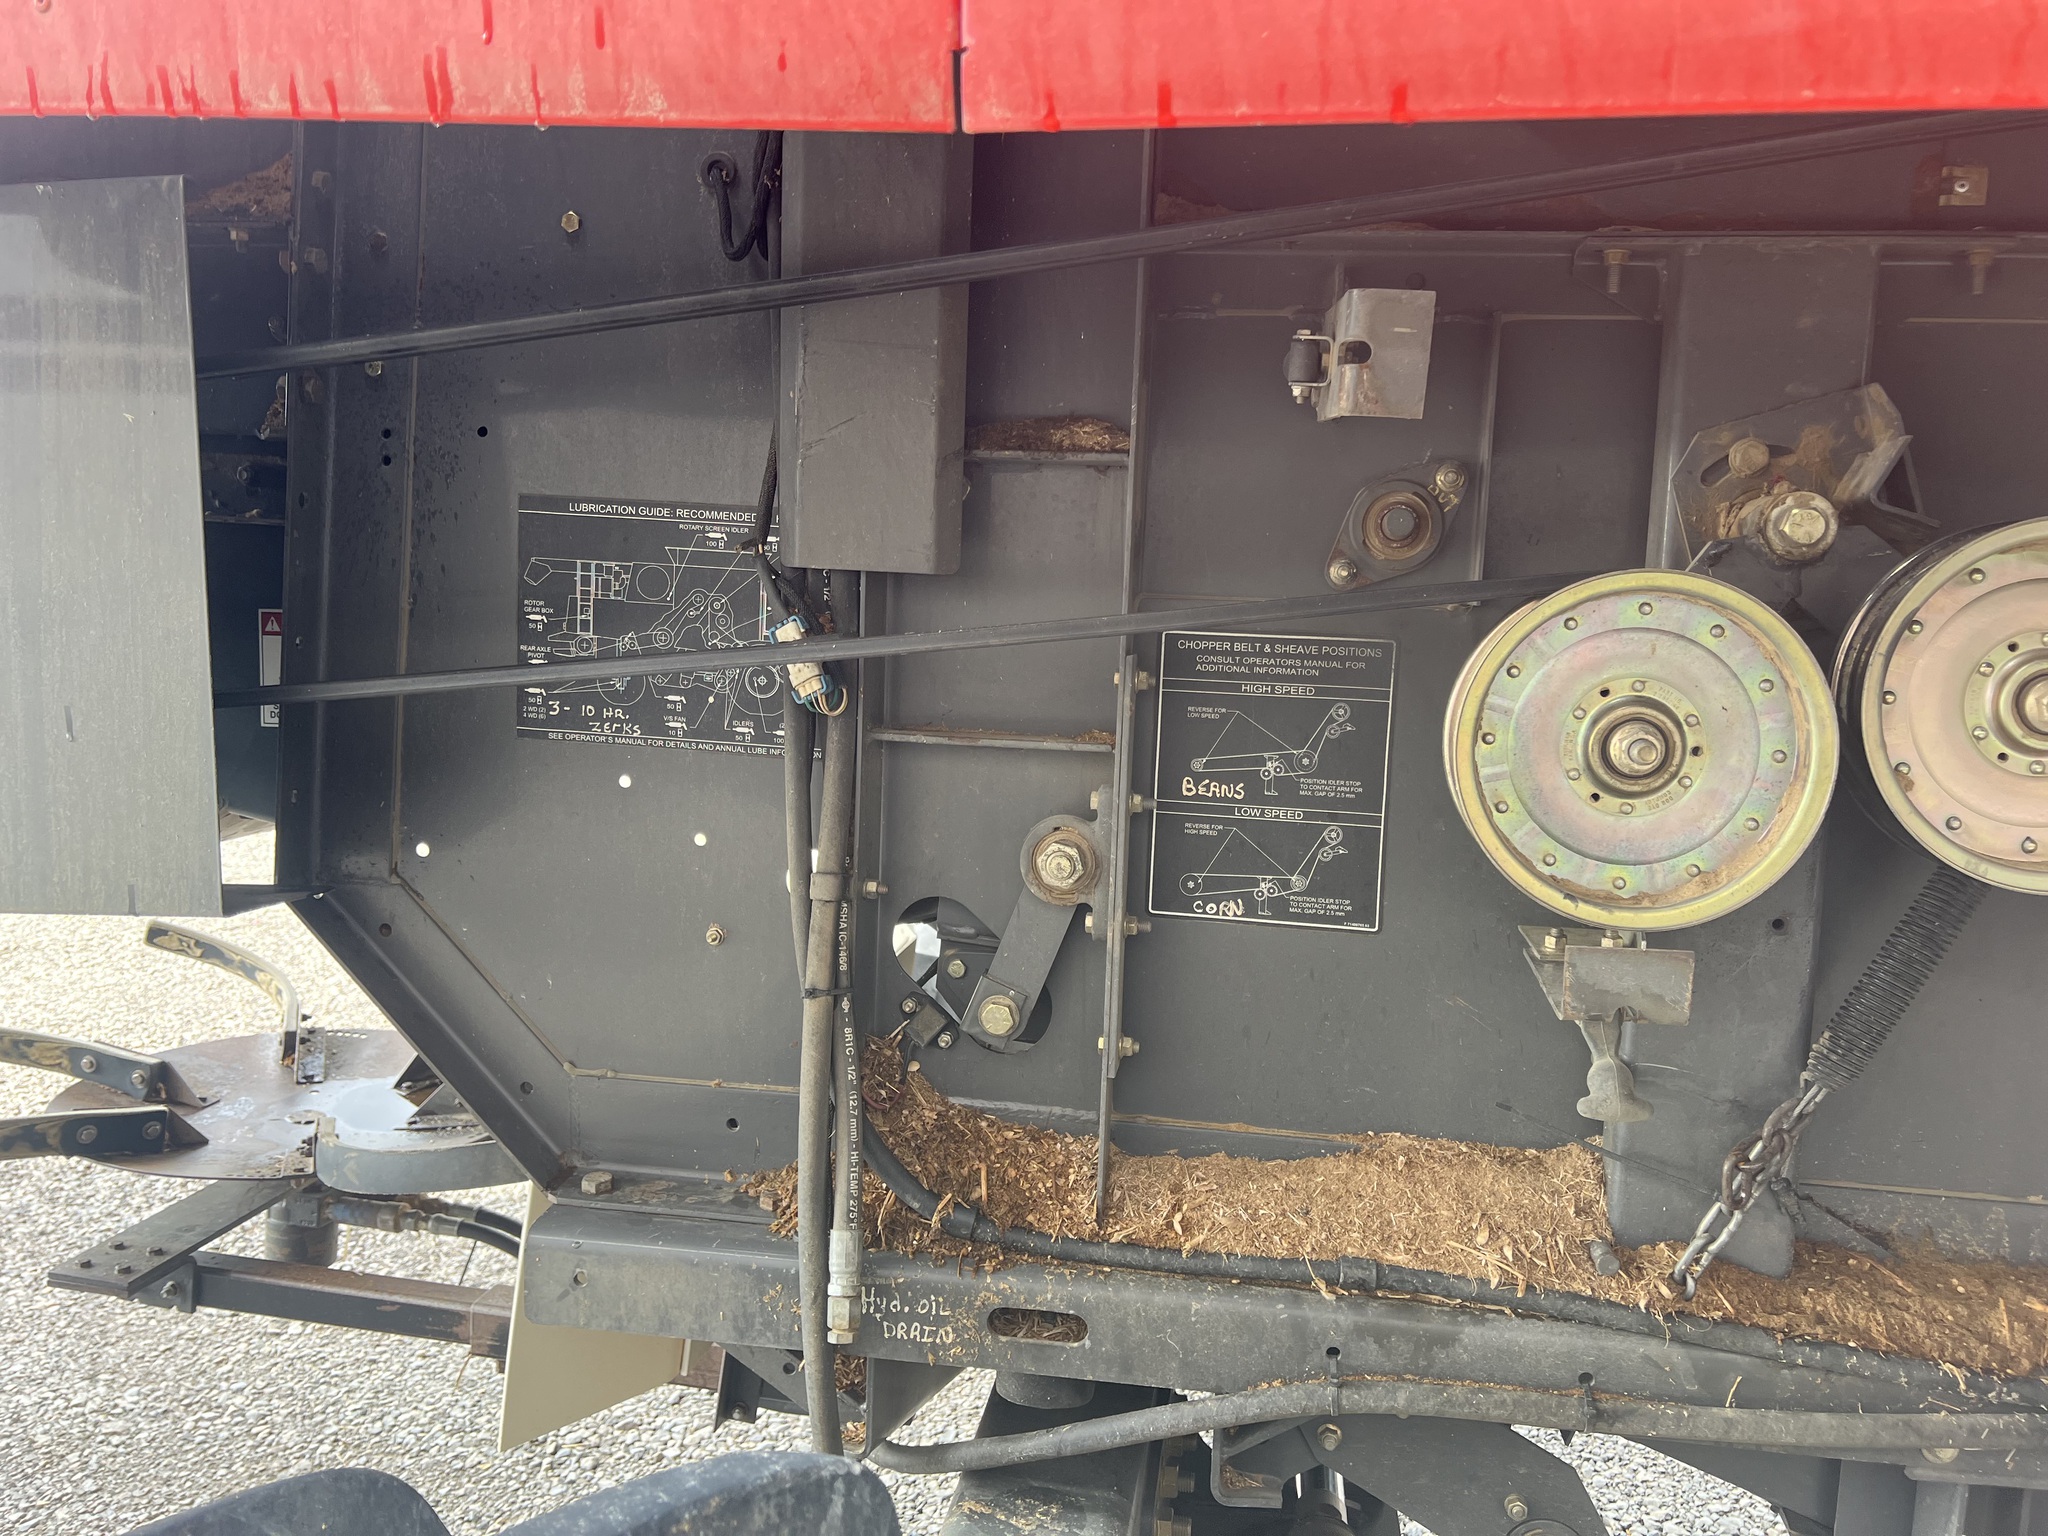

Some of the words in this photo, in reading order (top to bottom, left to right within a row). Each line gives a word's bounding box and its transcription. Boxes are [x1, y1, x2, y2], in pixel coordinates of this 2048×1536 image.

[569, 502, 636, 515] LUBRICATION
[638, 506, 674, 518] GUIDE:
[1178, 640, 1231, 651] CHOPPER
[1234, 643, 1261, 652] BELT
[1264, 644, 1271, 653] &
[1274, 644, 1319, 655] SHEAVE
[1322, 646, 1383, 658] POSITIONS
[1195, 664, 1251, 674] ADDITIONAL
[1254, 667, 1319, 676] INFORMATION
[1196, 655, 1241, 664] CONSULT
[1242, 657, 1301, 666] OPERATORS
[1304, 660, 1343, 668] MANUAL
[1241, 684, 1271, 694] HIGH
[1274, 686, 1315, 696] SPEED
[548, 700, 560, 715] 3
[582, 705, 595, 717] 10
[603, 707, 629, 720] HR.
[565, 733, 614, 743] OPERATOR'S
[615, 736, 646, 746] MANUAL
[666, 740, 696, 750] DETAILS
[716, 744, 746, 753] ANNUAL
[1235, 808, 1261, 817] LOW
[1264, 809, 1304, 820] SPEED
[839, 900, 847, 932] MSHA
[1193, 898, 1243, 917] CORN
[838, 932, 848, 971] IC-146/8
[844, 1028, 854, 1056] 8R1C
[847, 1065, 857, 1085] 1/2"
[849, 1090, 857, 1116] (12.7
[850, 1118, 858, 1143] mm)
[849, 1151, 859, 1197] HI-TEMP
[883, 1321, 953, 1343] DRAIN
